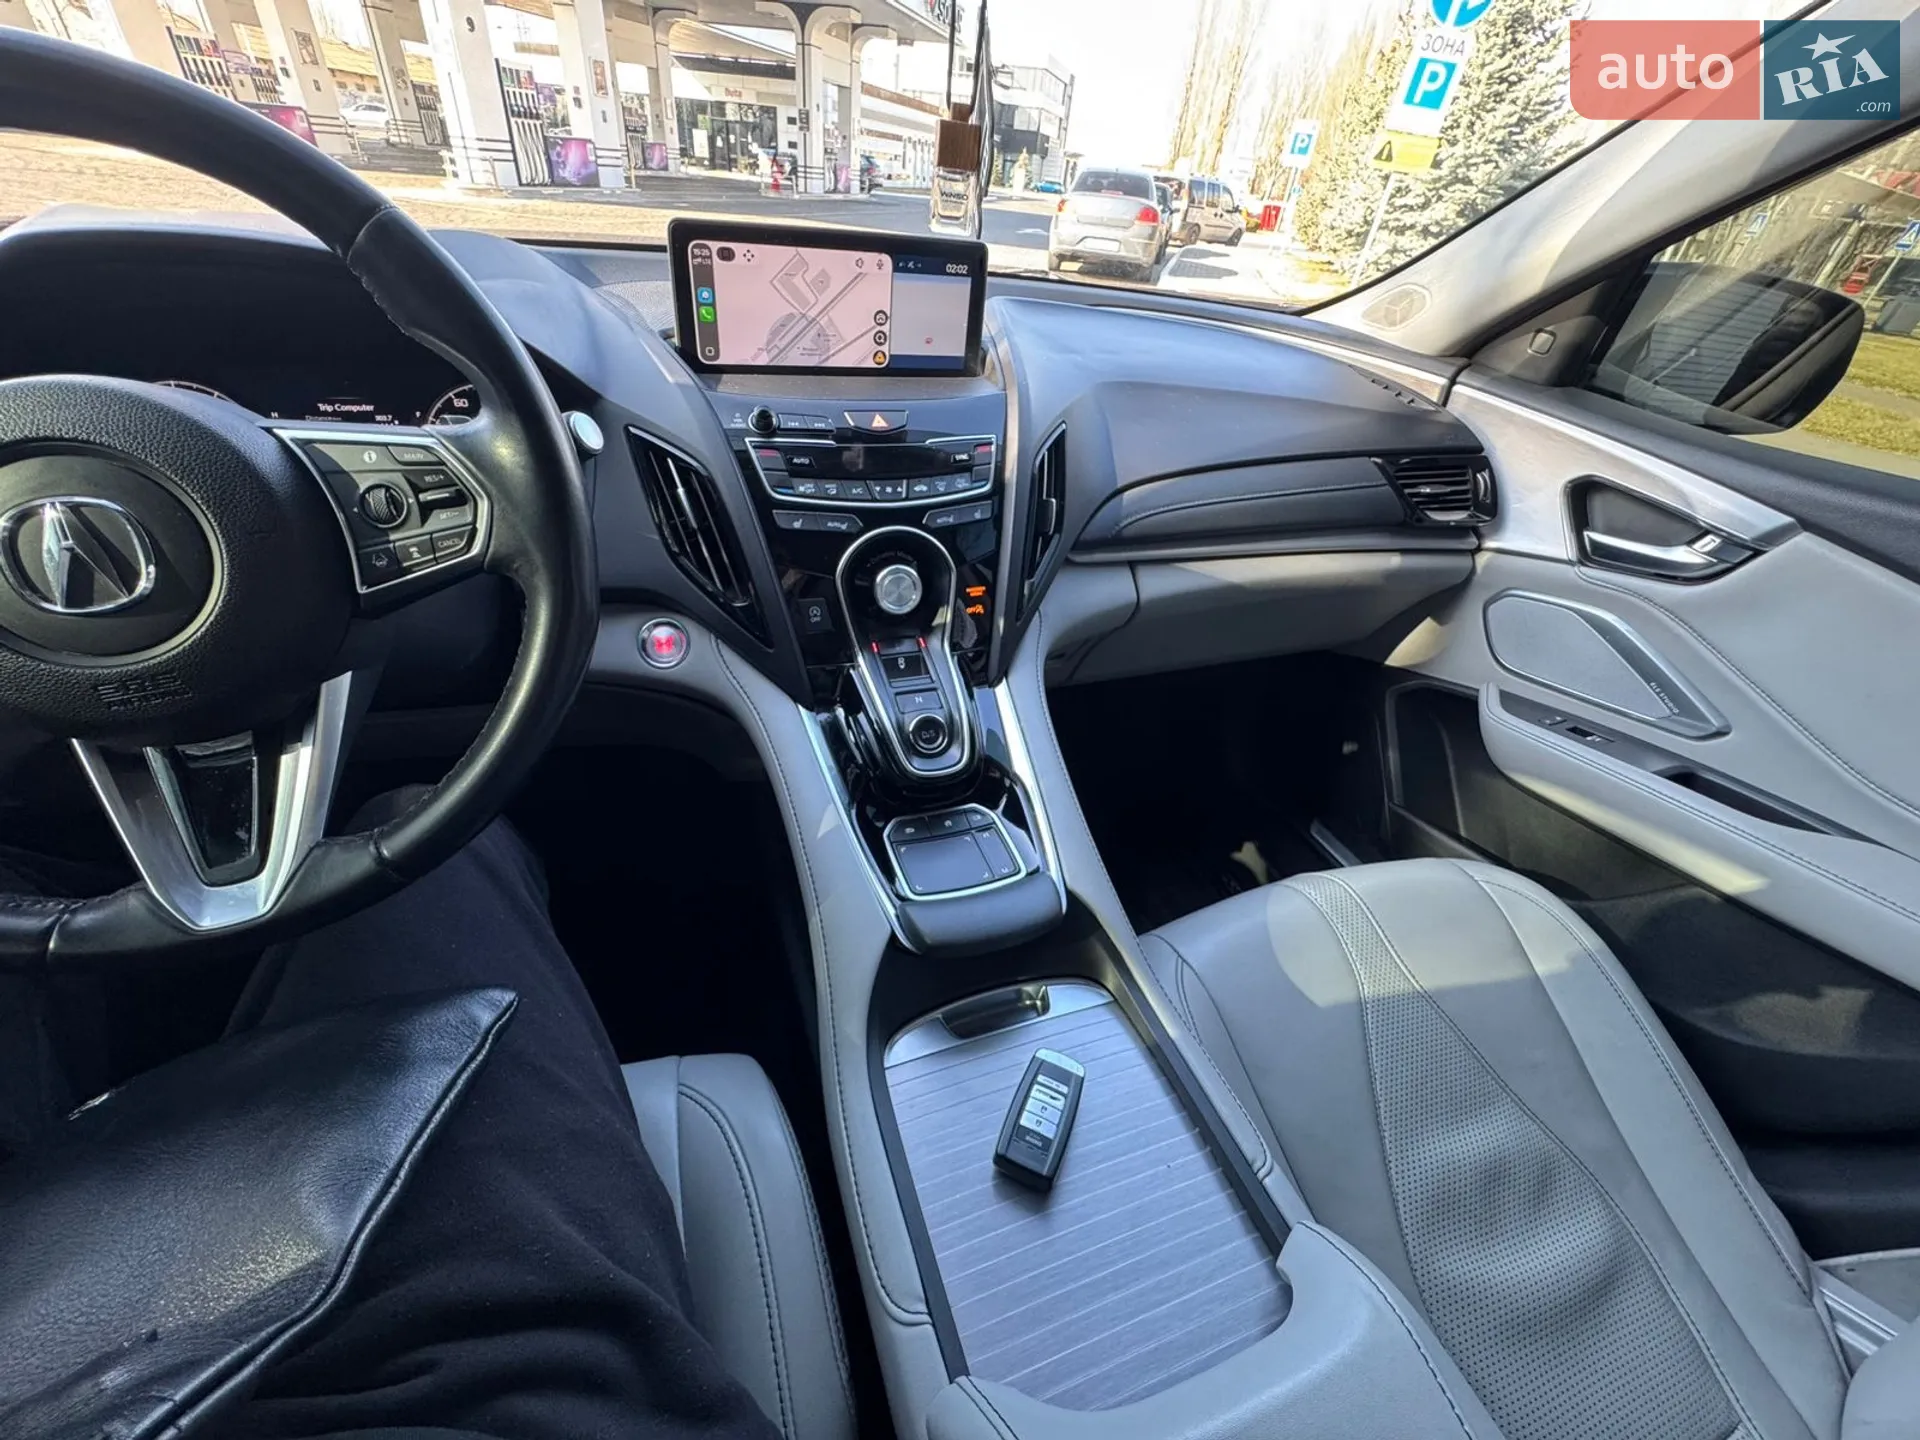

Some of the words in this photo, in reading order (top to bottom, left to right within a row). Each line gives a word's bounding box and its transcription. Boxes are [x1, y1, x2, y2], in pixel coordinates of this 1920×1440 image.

[466, 16, 476, 33] 9
[1421, 33, 1465, 57] ЗОНА
[1413, 61, 1447, 105] P
[945, 263, 969, 275] 02:02
[317, 403, 334, 412] Trip
[334, 404, 375, 412] Computer
[792, 457, 810, 465] AUTO
[437, 538, 462, 548] CANCEL
[914, 695, 923, 704] N
